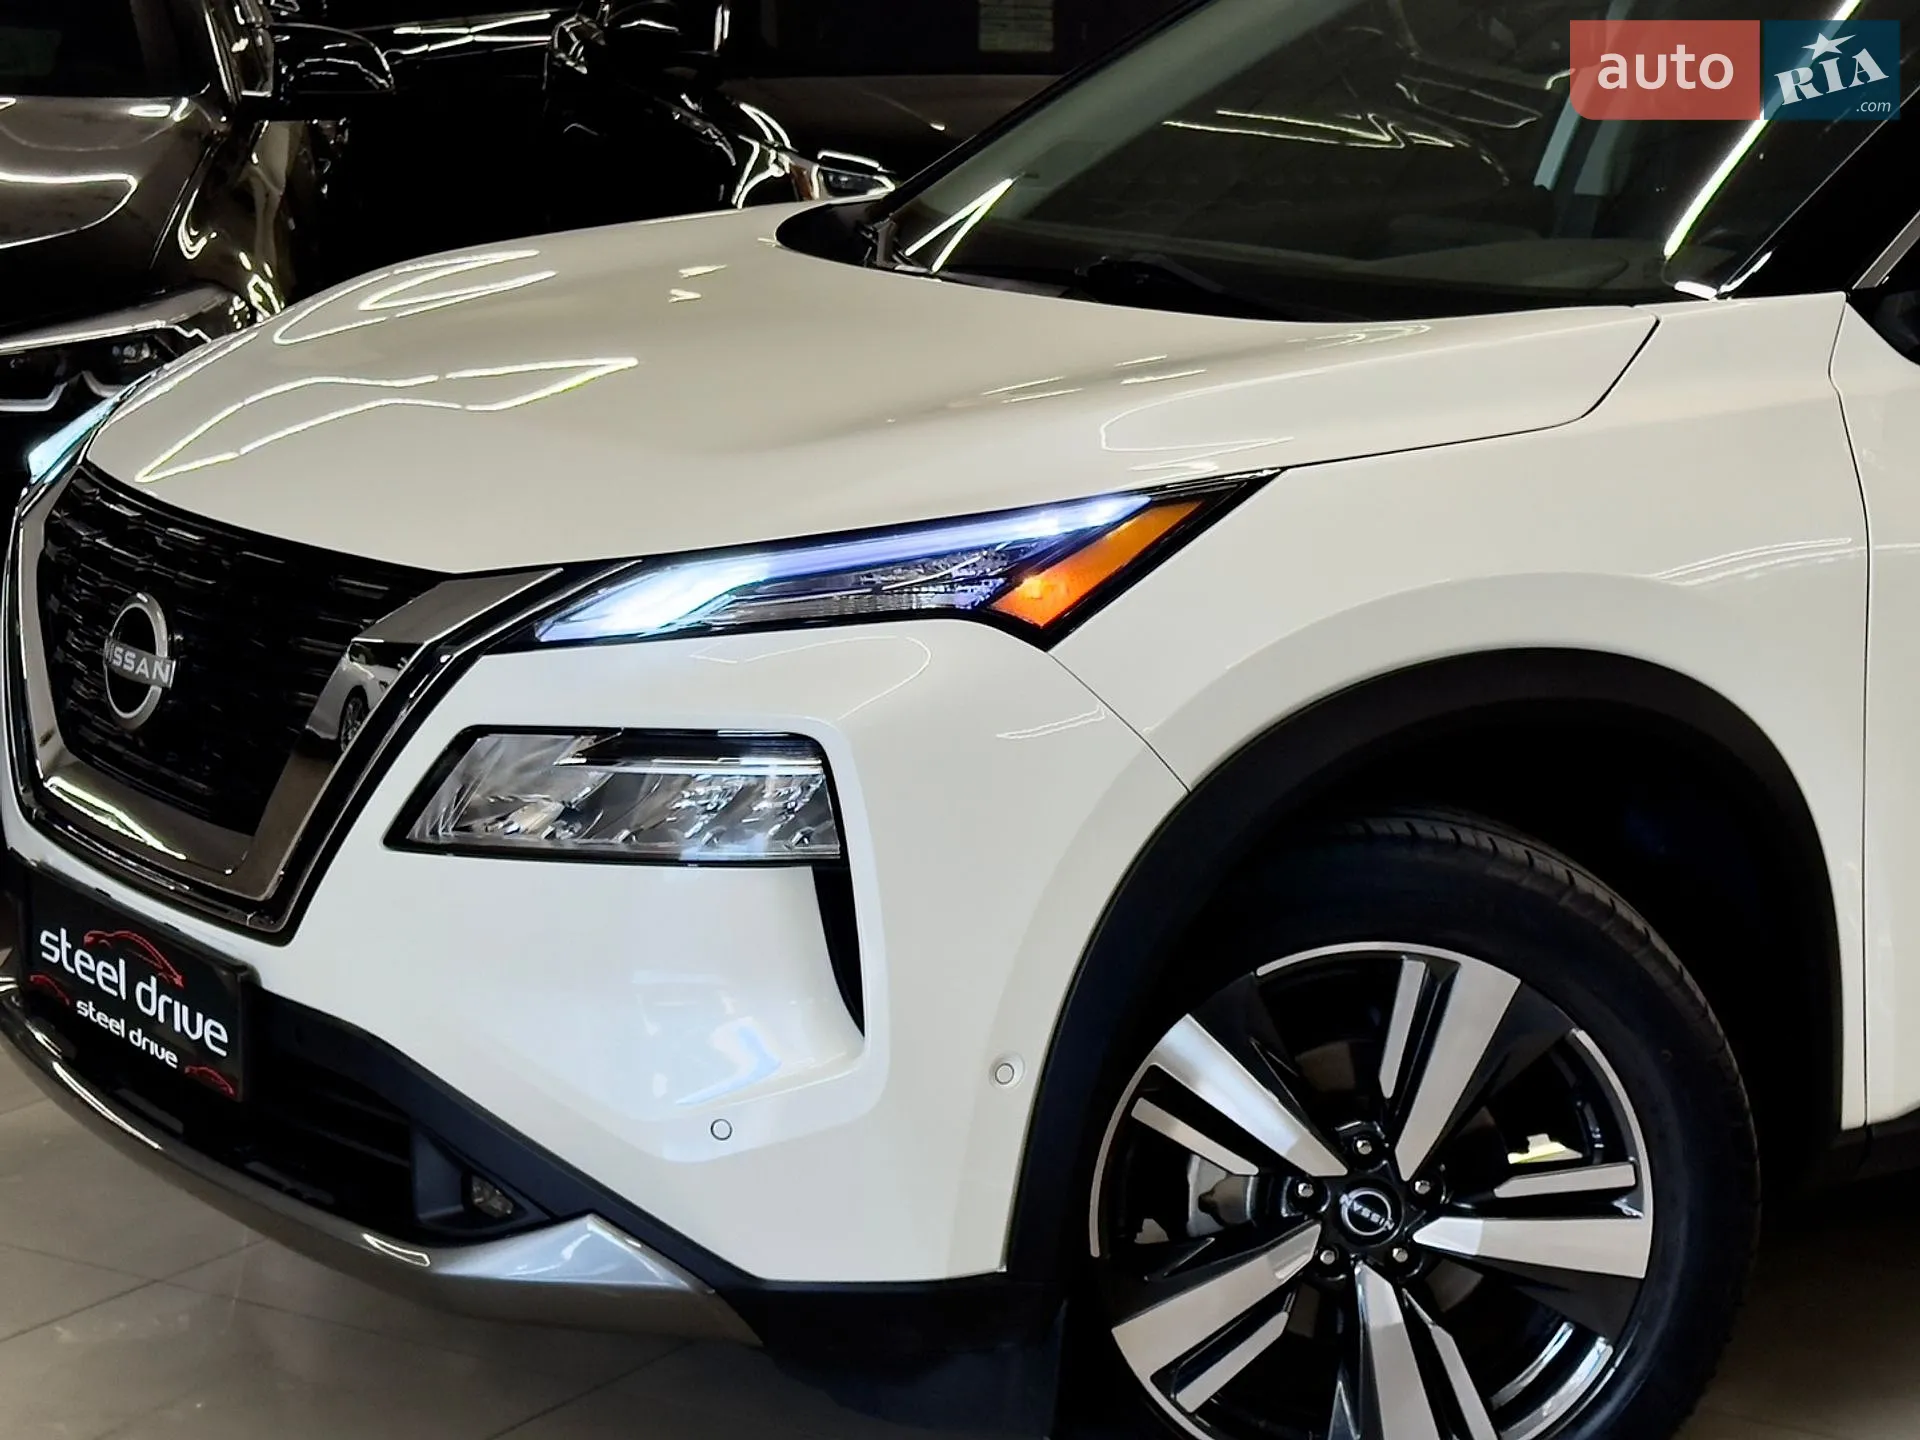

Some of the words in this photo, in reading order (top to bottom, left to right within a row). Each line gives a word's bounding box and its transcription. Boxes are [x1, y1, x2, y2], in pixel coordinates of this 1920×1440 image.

[40, 928, 127, 1000] steel
[135, 975, 229, 1057] drive
[76, 999, 126, 1038] steel
[129, 1028, 178, 1069] drive
